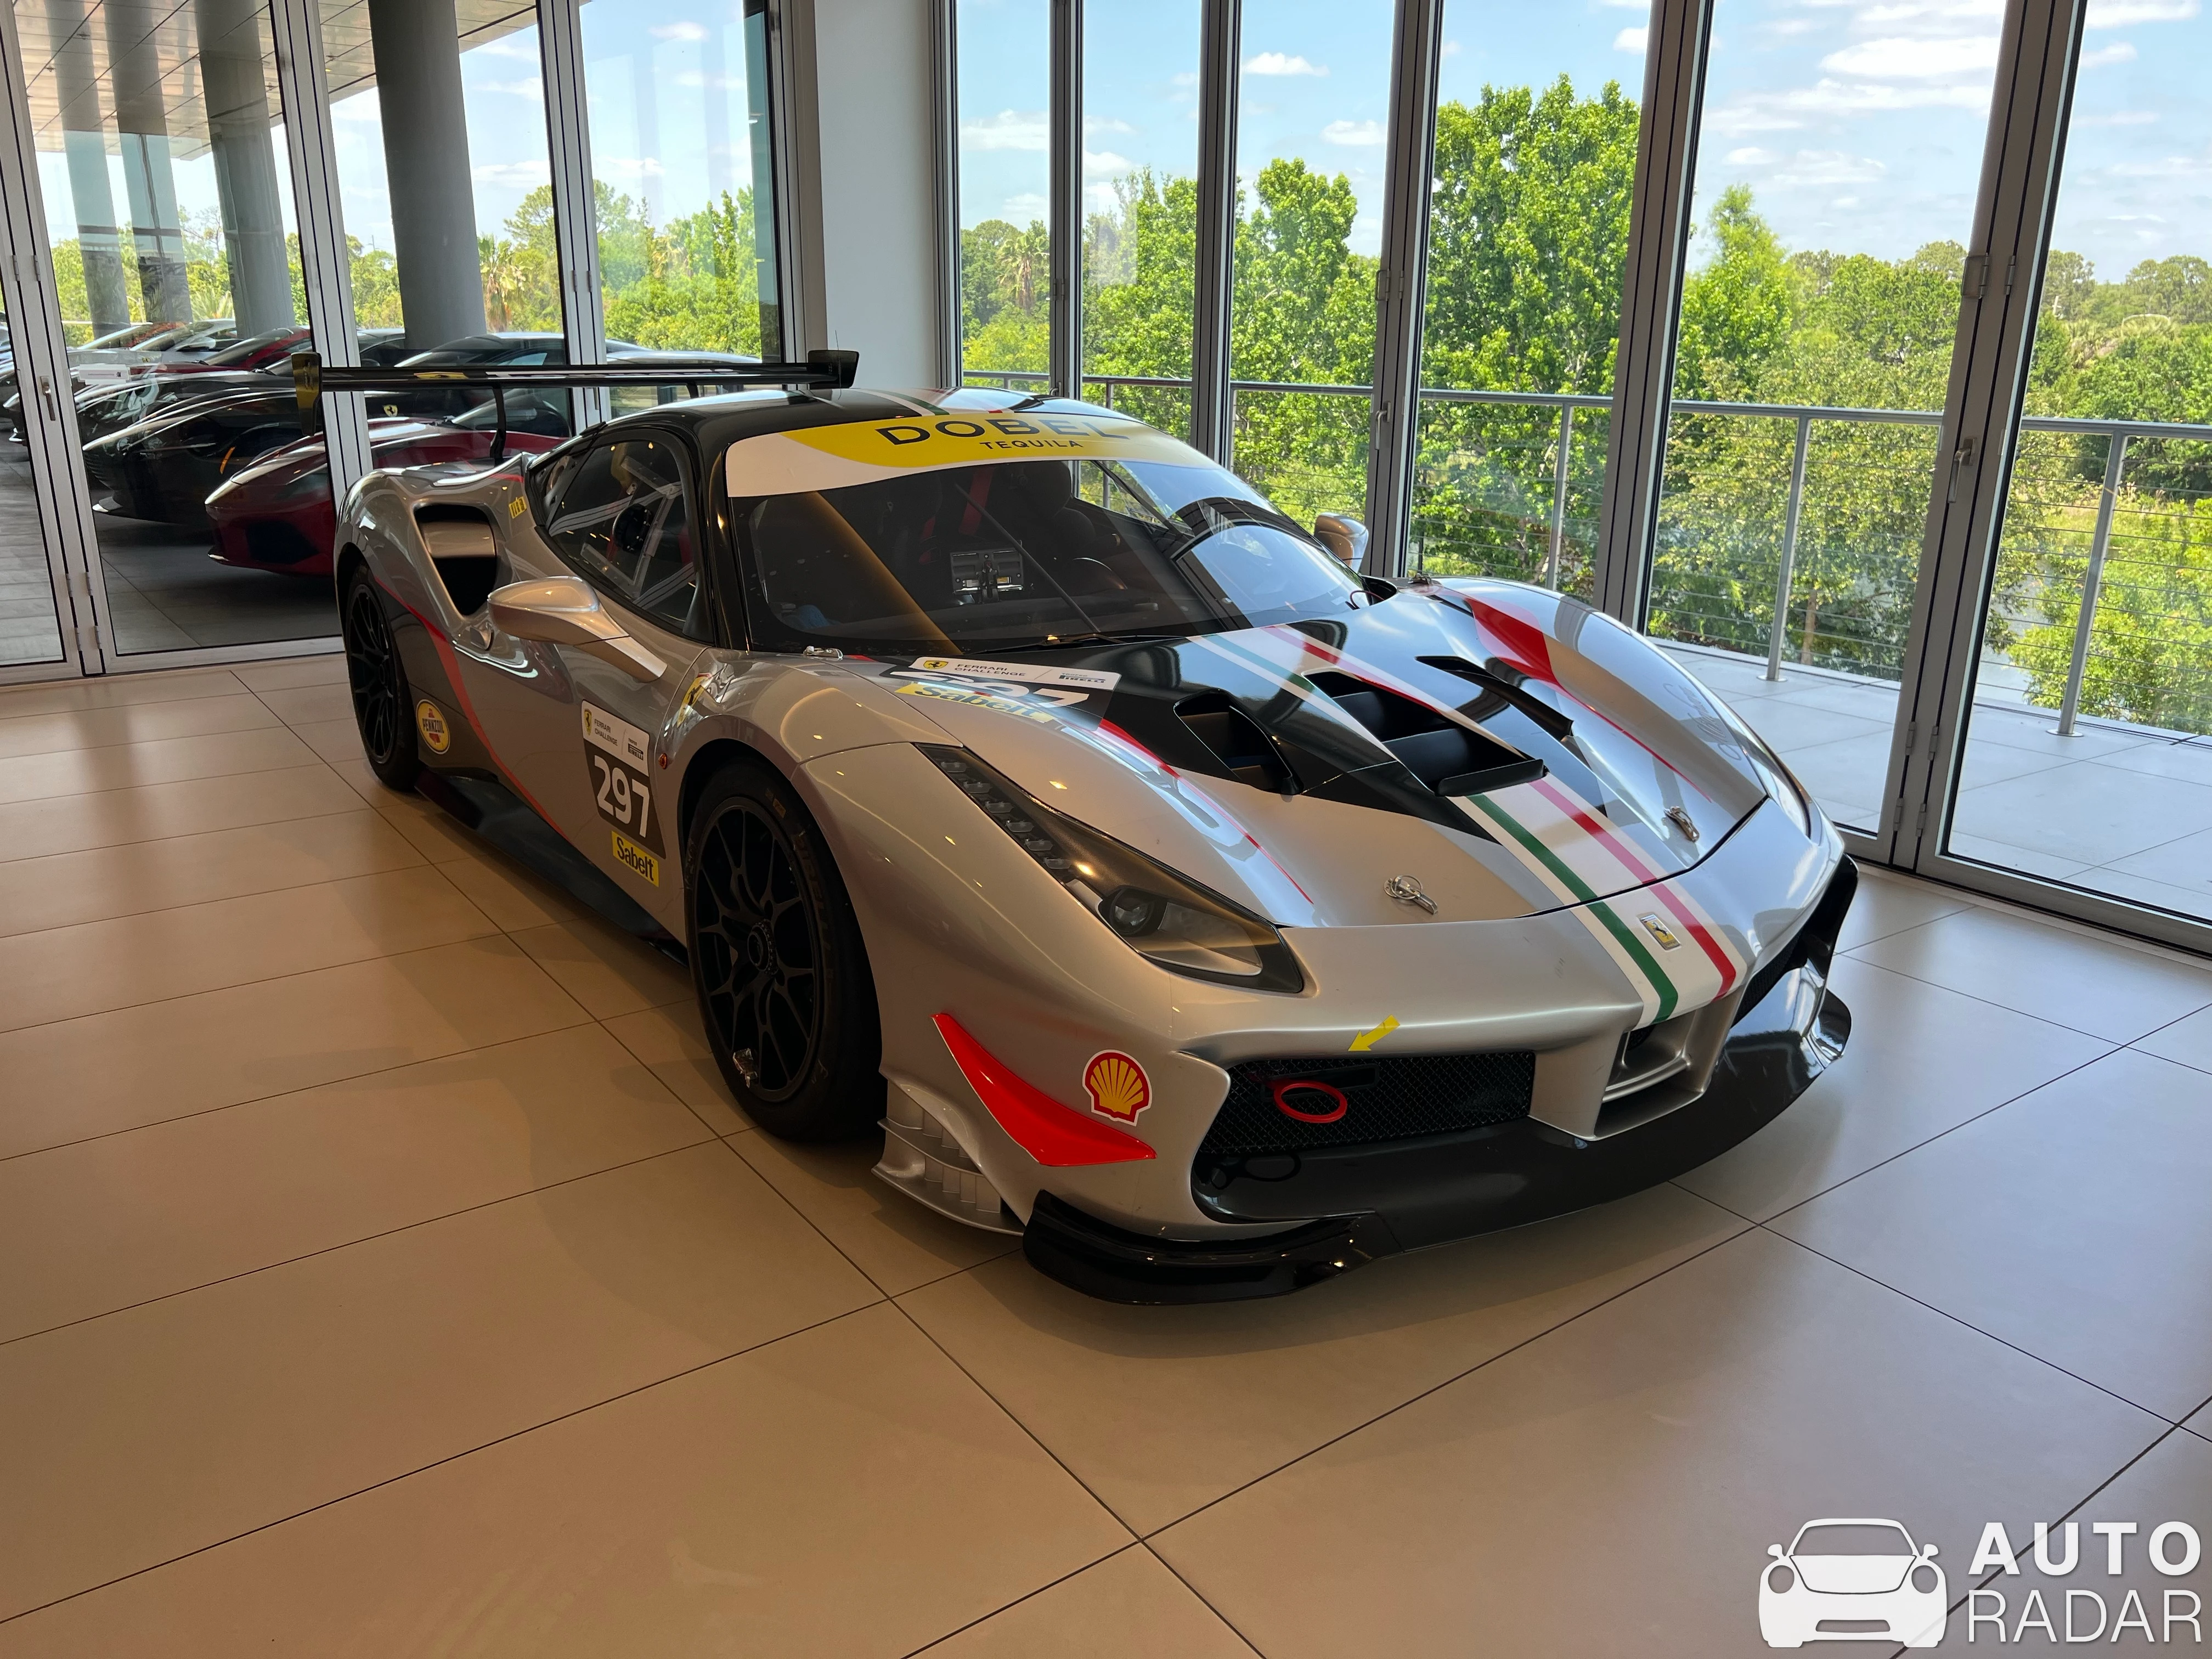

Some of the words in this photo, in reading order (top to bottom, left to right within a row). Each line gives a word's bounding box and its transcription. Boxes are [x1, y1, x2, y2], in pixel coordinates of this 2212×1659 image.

[875, 419, 1130, 445] DOBEL
[979, 439, 1084, 449] TEQUILA
[954, 667, 1026, 676] CHALLENGE
[915, 686, 1041, 718] Sabelt
[594, 719, 611, 733] FERRARI
[594, 728, 618, 746] CHALLENGE
[594, 755, 650, 838] 297
[616, 837, 654, 881] Sabelt
